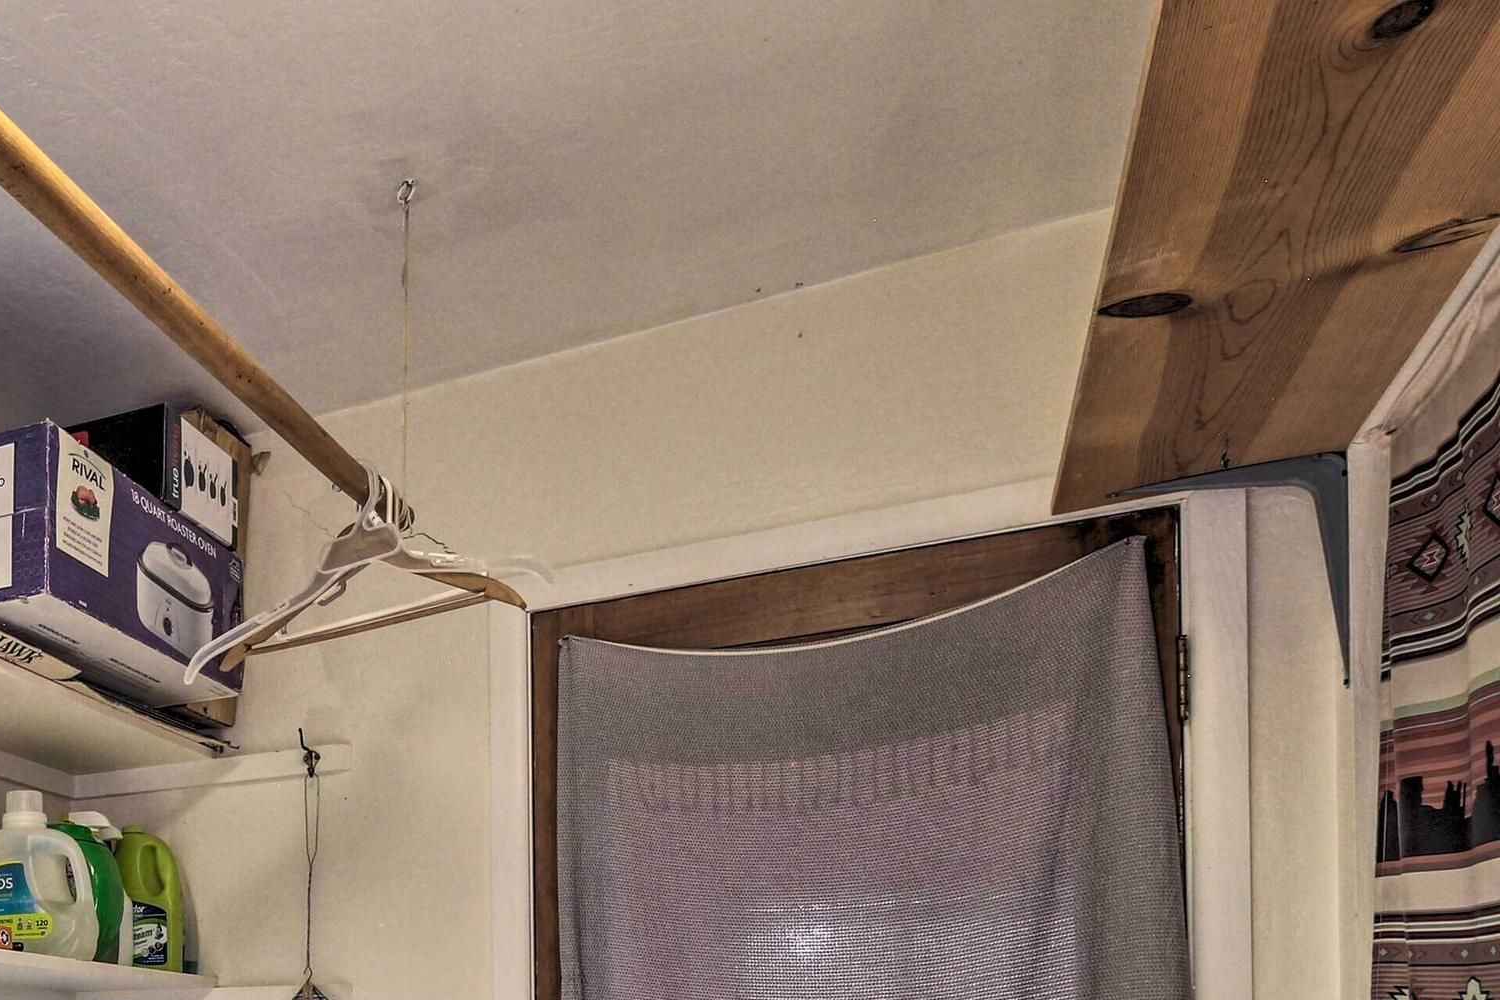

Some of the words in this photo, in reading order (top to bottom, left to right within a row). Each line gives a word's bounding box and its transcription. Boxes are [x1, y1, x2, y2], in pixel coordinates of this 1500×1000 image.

[71, 457, 107, 491] RIVAL
[172, 466, 180, 499] true
[131, 489, 140, 505] 18
[140, 496, 166, 523] QUART
[167, 514, 198, 546] ROASTER
[198, 538, 217, 559] OVEN
[35, 919, 49, 927] 120
